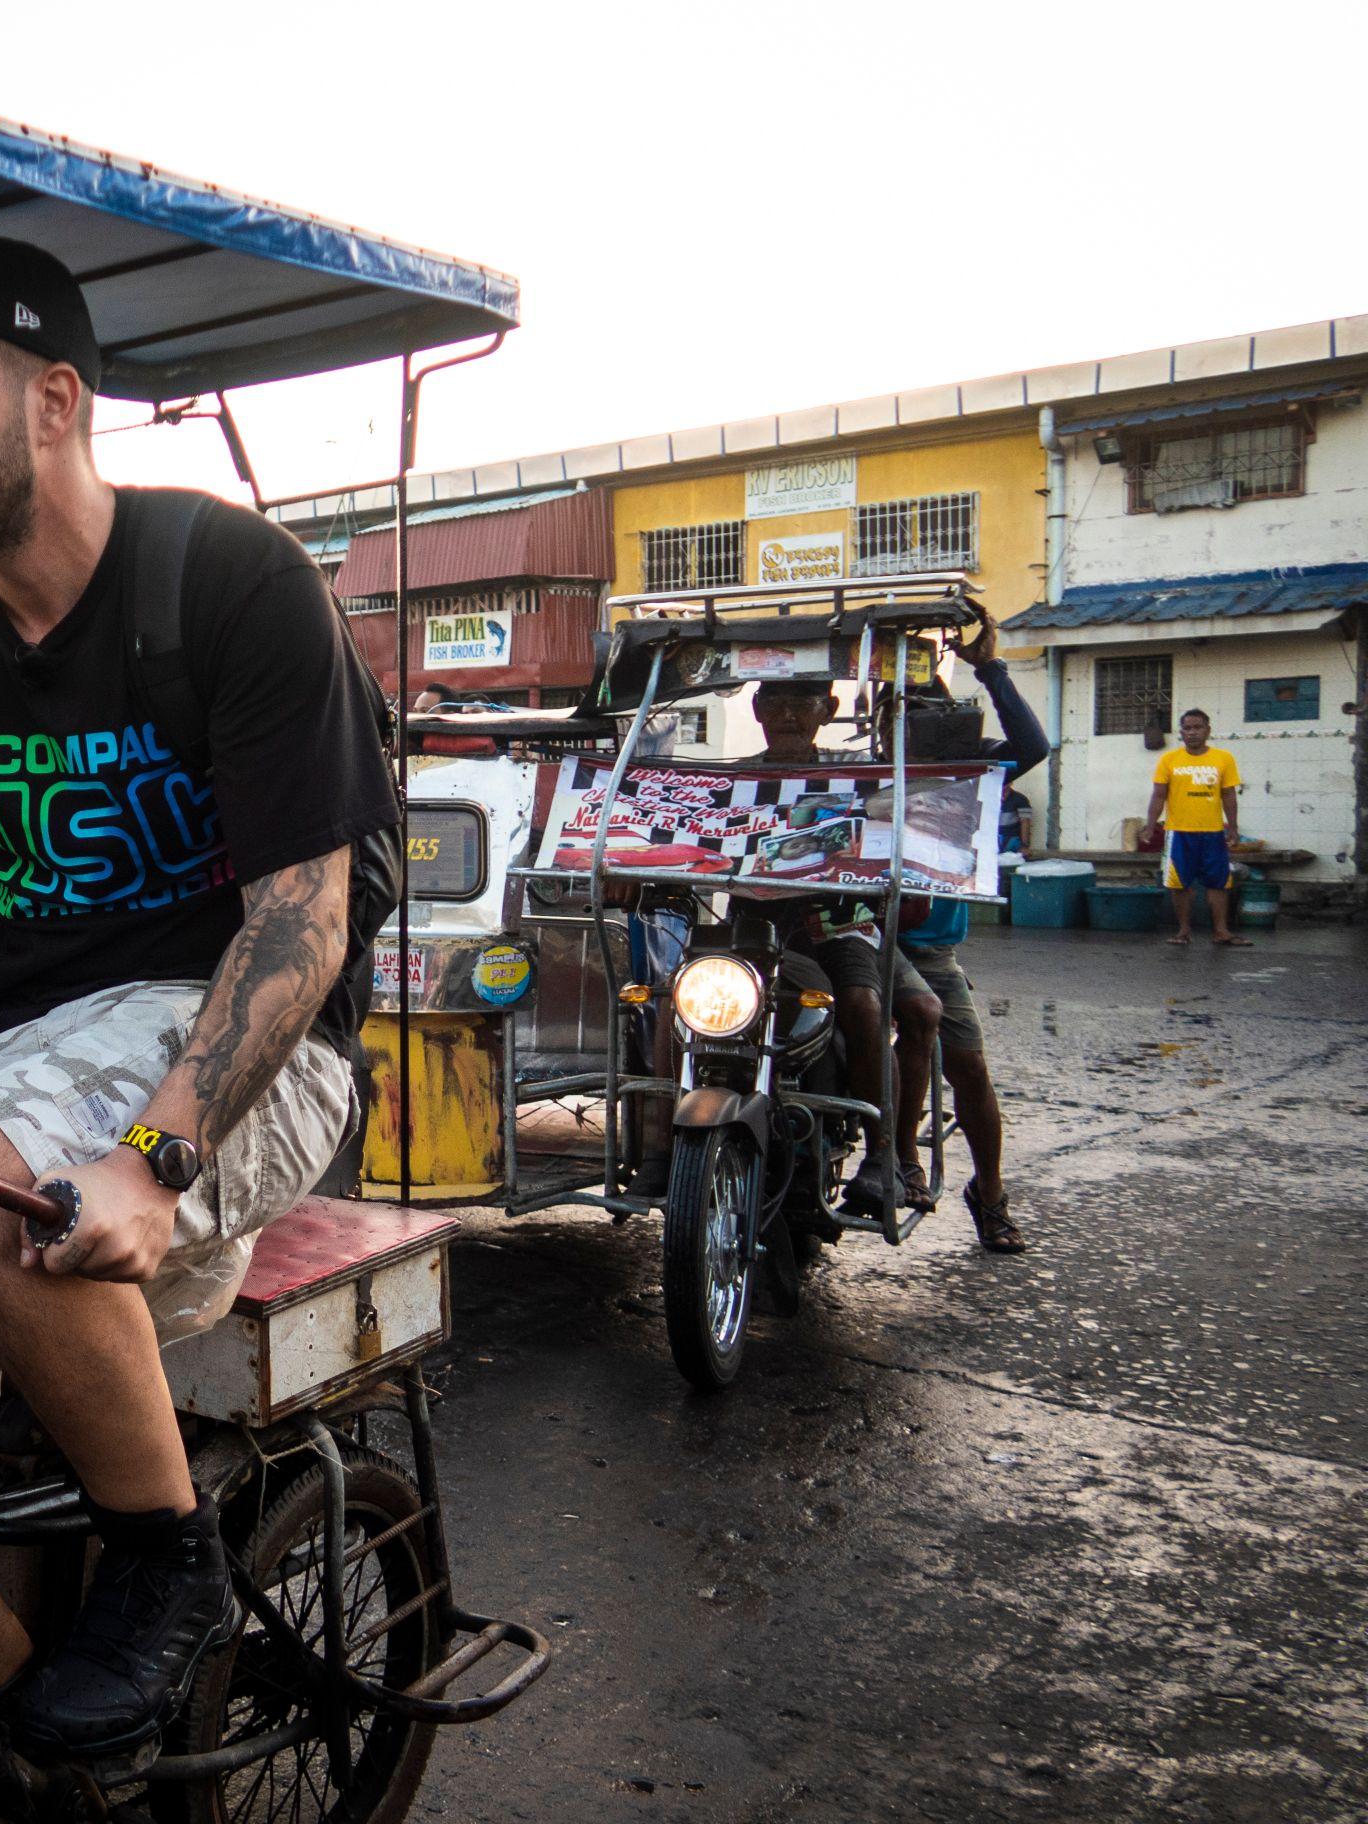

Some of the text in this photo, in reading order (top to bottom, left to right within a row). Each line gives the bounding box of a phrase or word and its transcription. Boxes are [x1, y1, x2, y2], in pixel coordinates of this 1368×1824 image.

[775, 458, 853, 493] ERICSON
[758, 488, 841, 509] FISH BROKER
[429, 616, 485, 643] Tita PINA
[429, 643, 486, 660] FISH BROKER
[628, 768, 731, 791] Welcome
[640, 785, 712, 804] to the
[569, 806, 655, 828] Nataniel
[704, 1043, 740, 1055] YAMAHA
